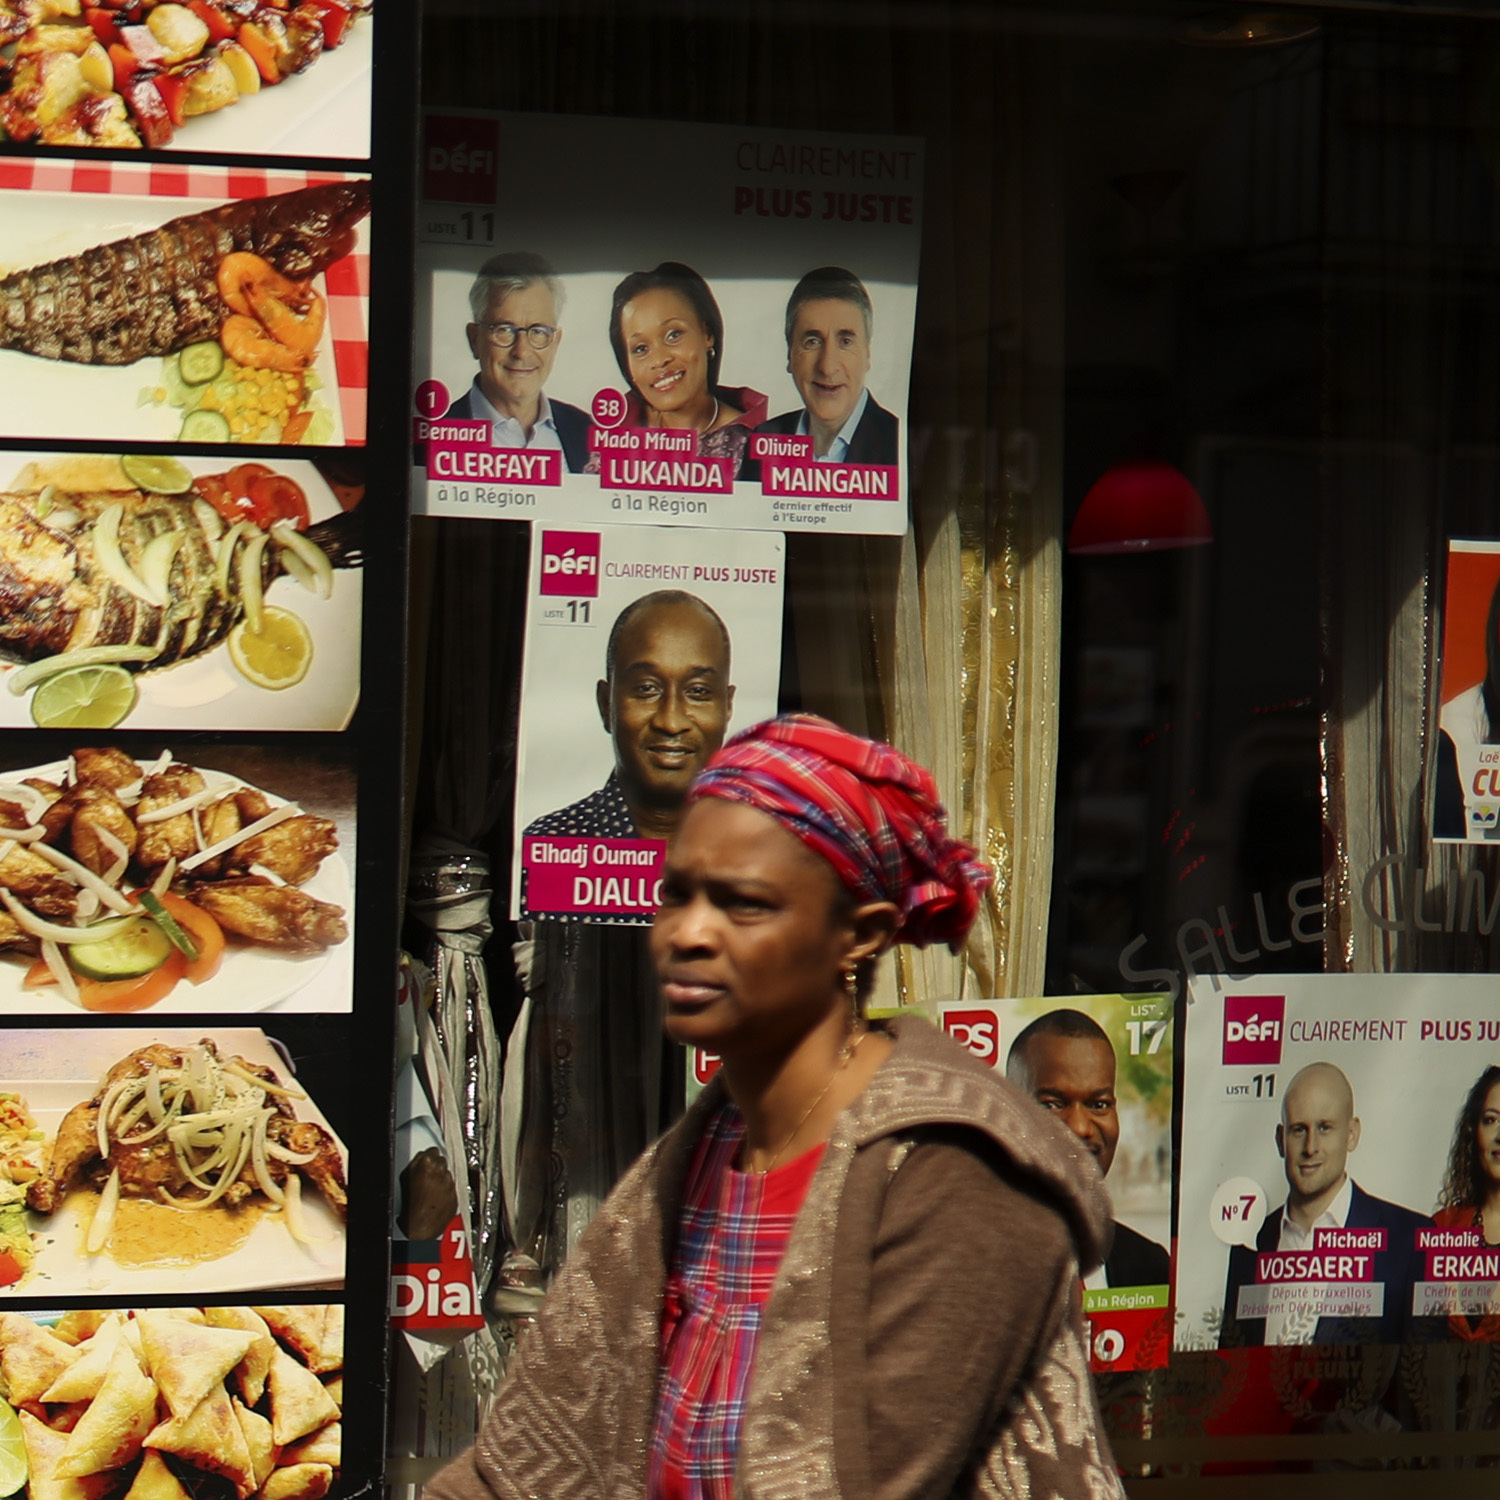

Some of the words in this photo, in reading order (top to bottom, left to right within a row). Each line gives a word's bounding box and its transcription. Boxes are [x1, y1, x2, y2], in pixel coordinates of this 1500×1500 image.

[428, 143, 494, 176] DéFI
[735, 140, 917, 181] CLAIREMENT
[733, 186, 812, 220] PLUS
[821, 190, 914, 225] JUSTE
[427, 222, 457, 235] LISTE
[460, 210, 495, 243] 11
[427, 391, 436, 408] 1
[597, 398, 620, 417] 38
[418, 422, 487, 443] Bernard
[594, 429, 640, 449] Mado
[645, 431, 692, 452] Mfuni
[755, 436, 808, 457] Olivier
[434, 450, 551, 481] CLERFAYT
[609, 457, 724, 489] LUKANDA
[771, 466, 889, 497] MAINGAIN
[437, 487, 448, 502] à
[453, 487, 469, 503] la
[477, 488, 536, 507] Région
[611, 495, 623, 510] à
[628, 495, 644, 511] la
[649, 496, 708, 514] Région
[773, 501, 812, 511] dernier
[814, 502, 852, 512] effectif
[543, 548, 597, 576] DéFI
[605, 563, 690, 581] CLAIREMENT
[694, 567, 729, 581] PLUS
[733, 568, 777, 583] JUSTE
[544, 610, 564, 618] LISTE
[567, 600, 591, 624] 11
[530, 842, 588, 868] Elhadj
[593, 844, 658, 866] Oumar
[1118, 877, 1325, 1036] SALLE
[1125, 1021, 1167, 1056] 17
[1226, 1013, 1280, 1043] DéFI
[1290, 1020, 1407, 1042] CLAIREMENT
[1420, 1020, 1472, 1041] PLUS
[1477, 1020, 1500, 1041] JU
[1226, 1086, 1249, 1095] LISTE
[1252, 1073, 1276, 1098] 11
[1240, 1196, 1257, 1221] 7
[1318, 1231, 1382, 1249] Michaël
[1419, 1231, 1480, 1249] Nathalie
[1260, 1256, 1369, 1280] VOSSAERT
[1433, 1255, 1499, 1278] ERKAN
[1098, 1296, 1108, 1307] la
[1111, 1292, 1155, 1309] Région
[1272, 1286, 1309, 1299] Député
[1313, 1286, 1372, 1299] bruxellois
